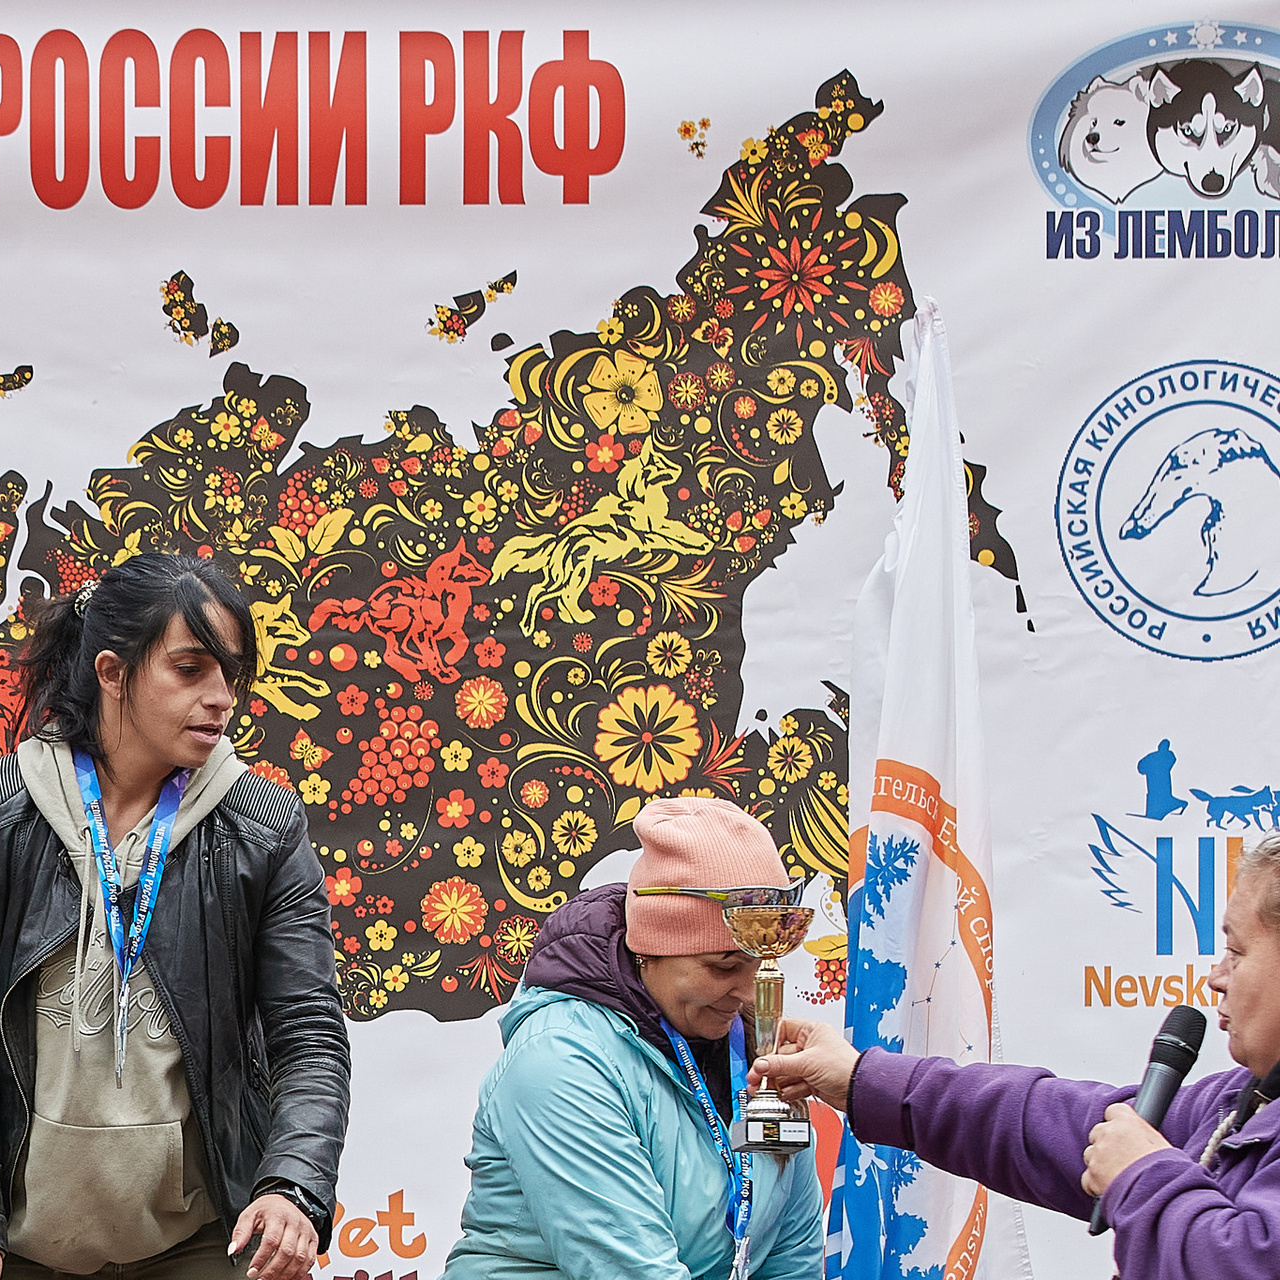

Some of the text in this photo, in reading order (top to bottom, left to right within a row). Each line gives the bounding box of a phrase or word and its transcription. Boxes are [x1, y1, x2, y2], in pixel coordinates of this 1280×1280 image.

[399, 28, 626, 206] РКФ
[1046, 210, 1101, 260] ИЗ
[1085, 369, 1280, 452] КИНОЛОГИЧЕ
[1066, 456, 1168, 641] РОССИЙСКАЯ
